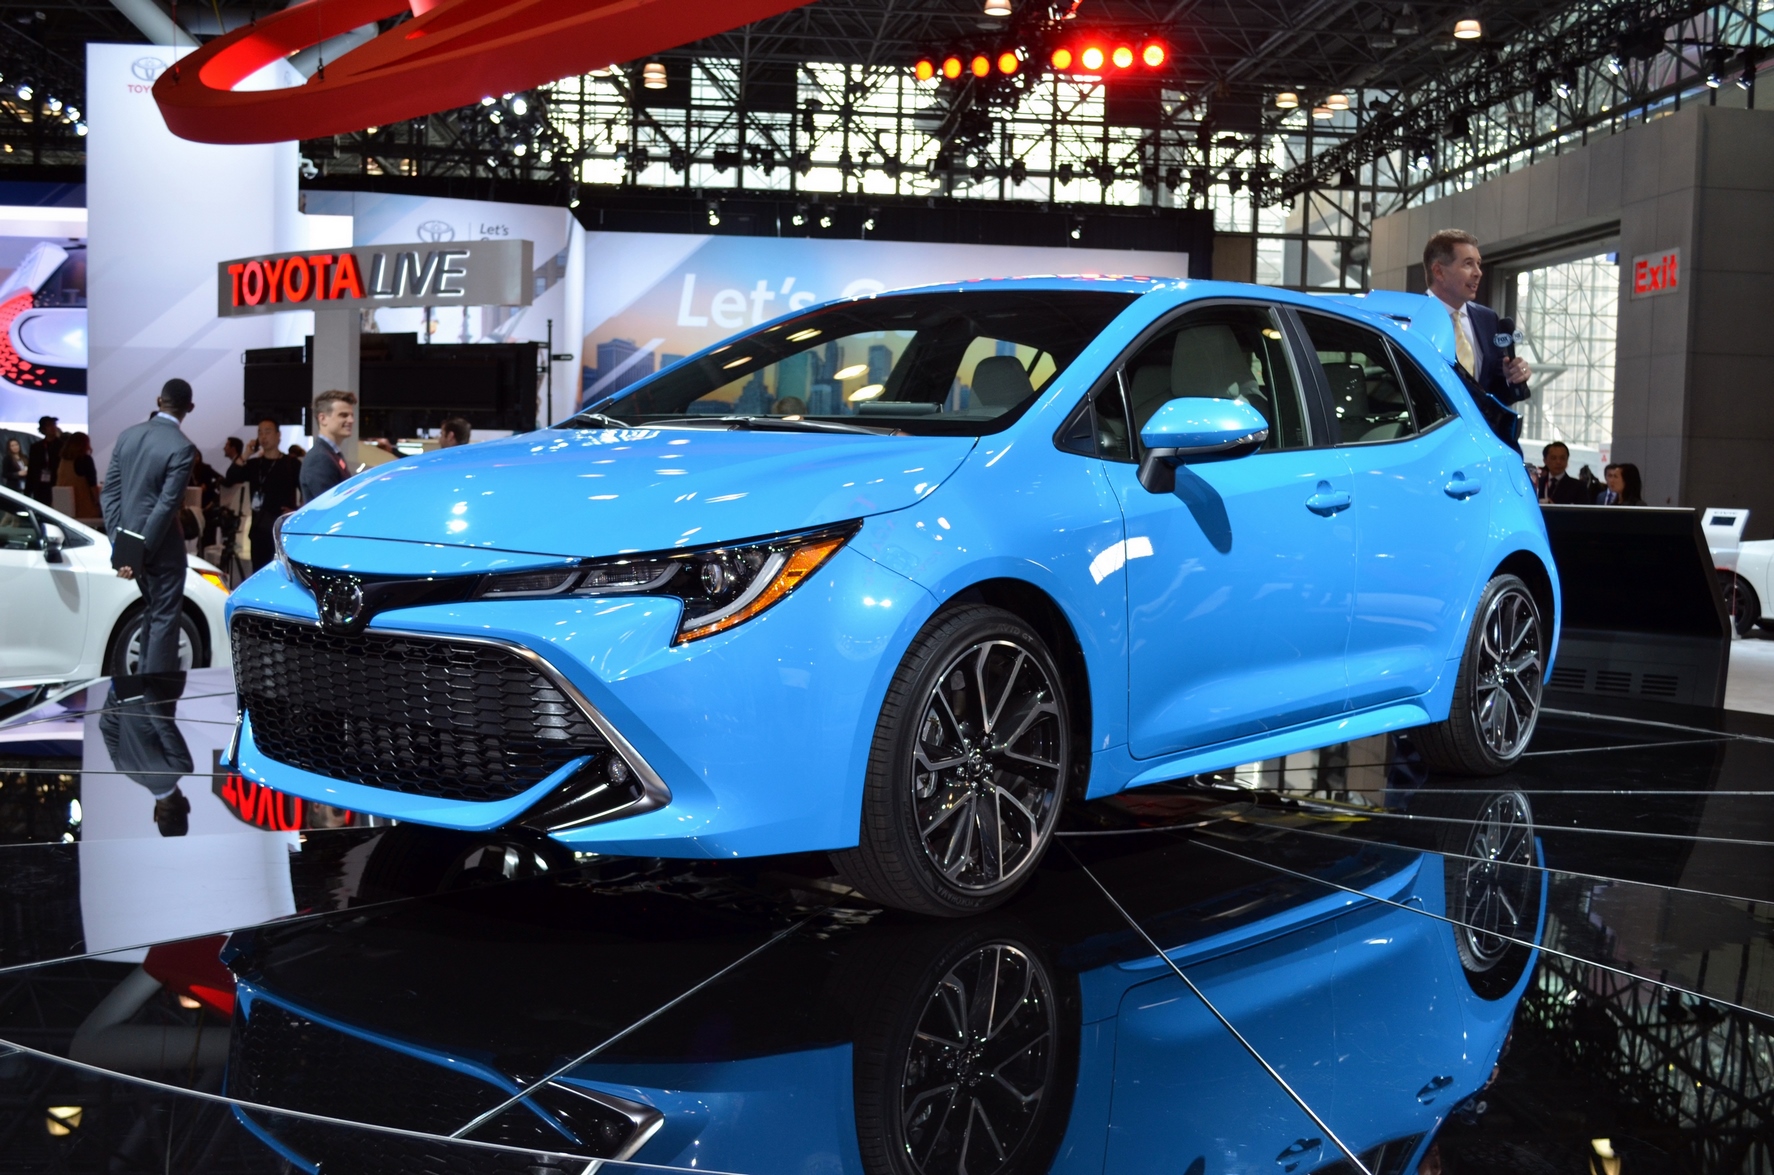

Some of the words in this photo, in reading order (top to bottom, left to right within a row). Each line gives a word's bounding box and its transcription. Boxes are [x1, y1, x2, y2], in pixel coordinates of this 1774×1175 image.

[127, 84, 151, 94] TOY
[480, 223, 509, 236] Let's
[228, 253, 366, 307] TOYOTA
[367, 250, 470, 299] LIVE
[1634, 254, 1678, 295] Exit
[1021, 632, 1034, 643] GT
[937, 885, 975, 907] YOKOHAMA
